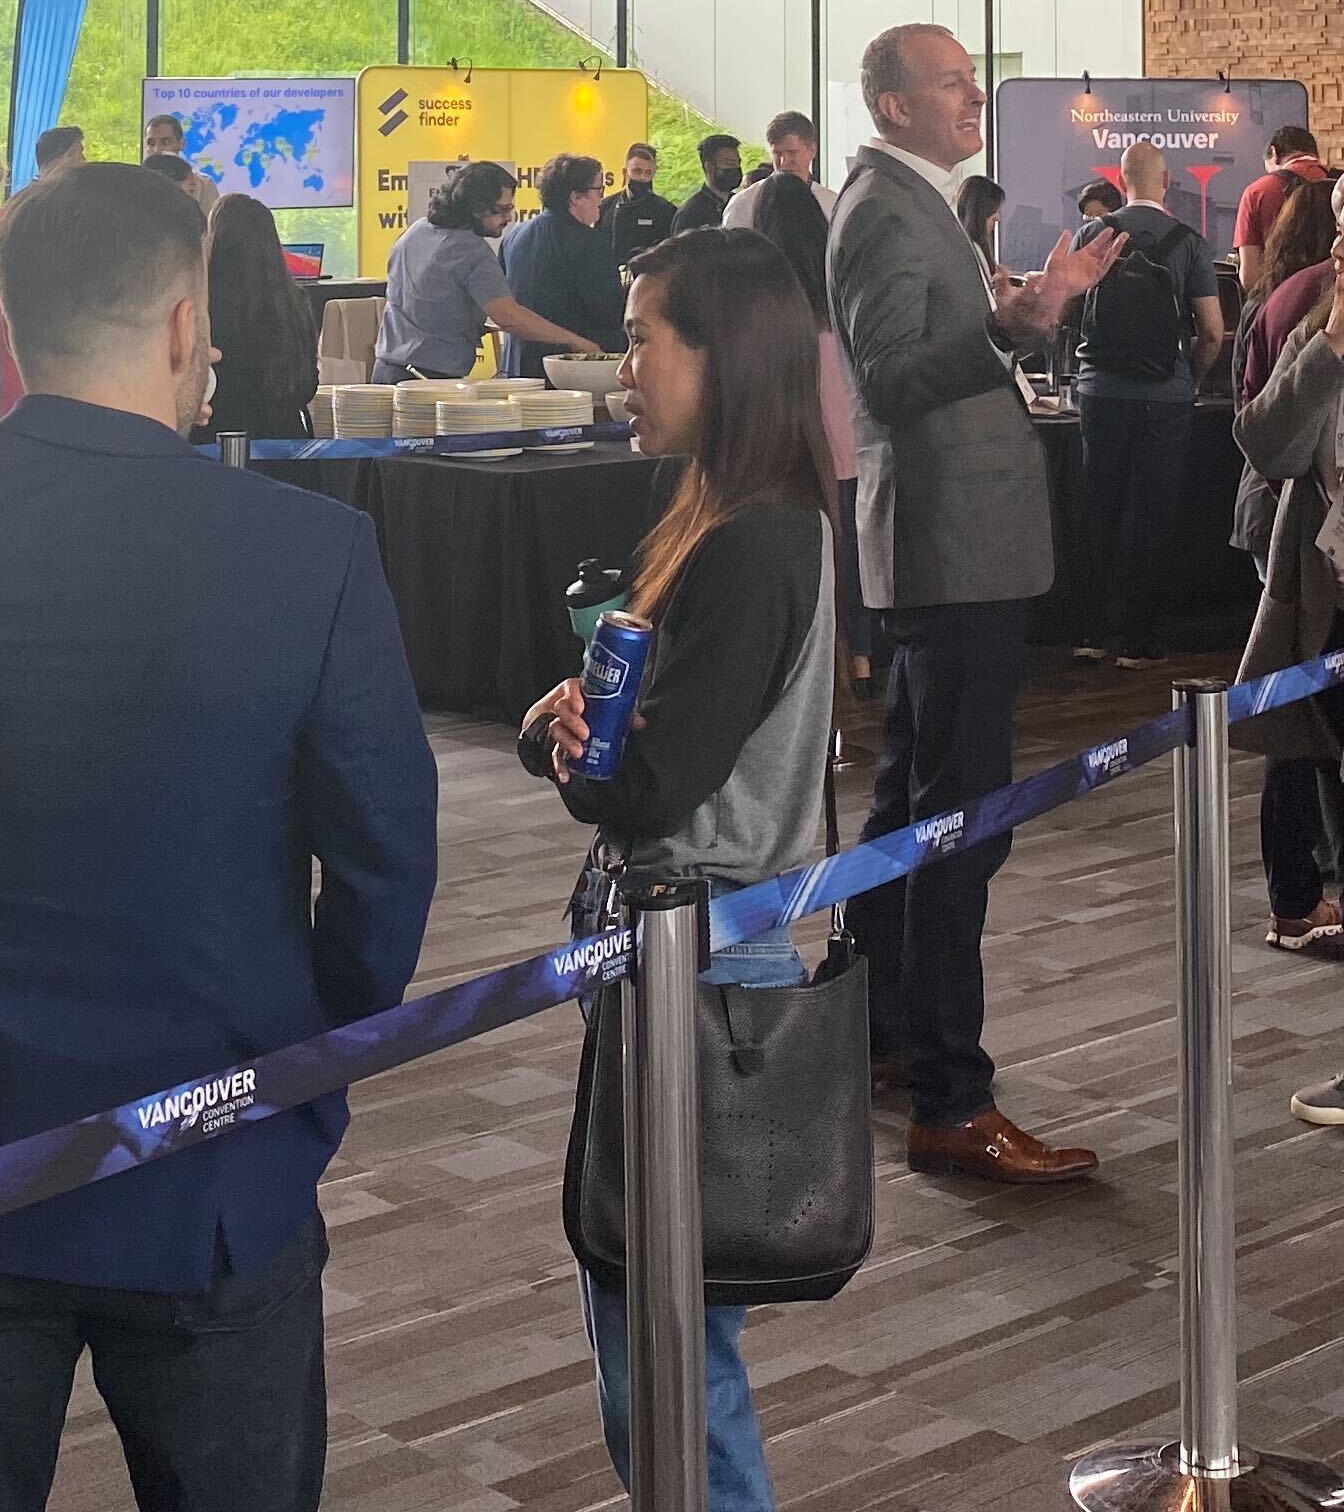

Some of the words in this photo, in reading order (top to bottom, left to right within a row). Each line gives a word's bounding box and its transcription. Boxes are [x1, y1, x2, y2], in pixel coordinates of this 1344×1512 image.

[154, 88, 175, 100] Top
[179, 88, 191, 98] 10
[193, 88, 247, 98] countries
[250, 87, 261, 98] of
[263, 89, 282, 98] our
[284, 88, 344, 100] developers
[419, 98, 472, 110] success
[419, 112, 460, 126] finder
[1071, 109, 1162, 122] Northeastern
[1168, 109, 1240, 125] University
[915, 811, 964, 843] VANCOUVER
[554, 929, 633, 977] VANCOUVE
[602, 963, 627, 981] CENTRE
[138, 1068, 256, 1129] VANCOUVER
[202, 1095, 254, 1122] CONVENTION
[202, 1114, 235, 1133] CENTRE
